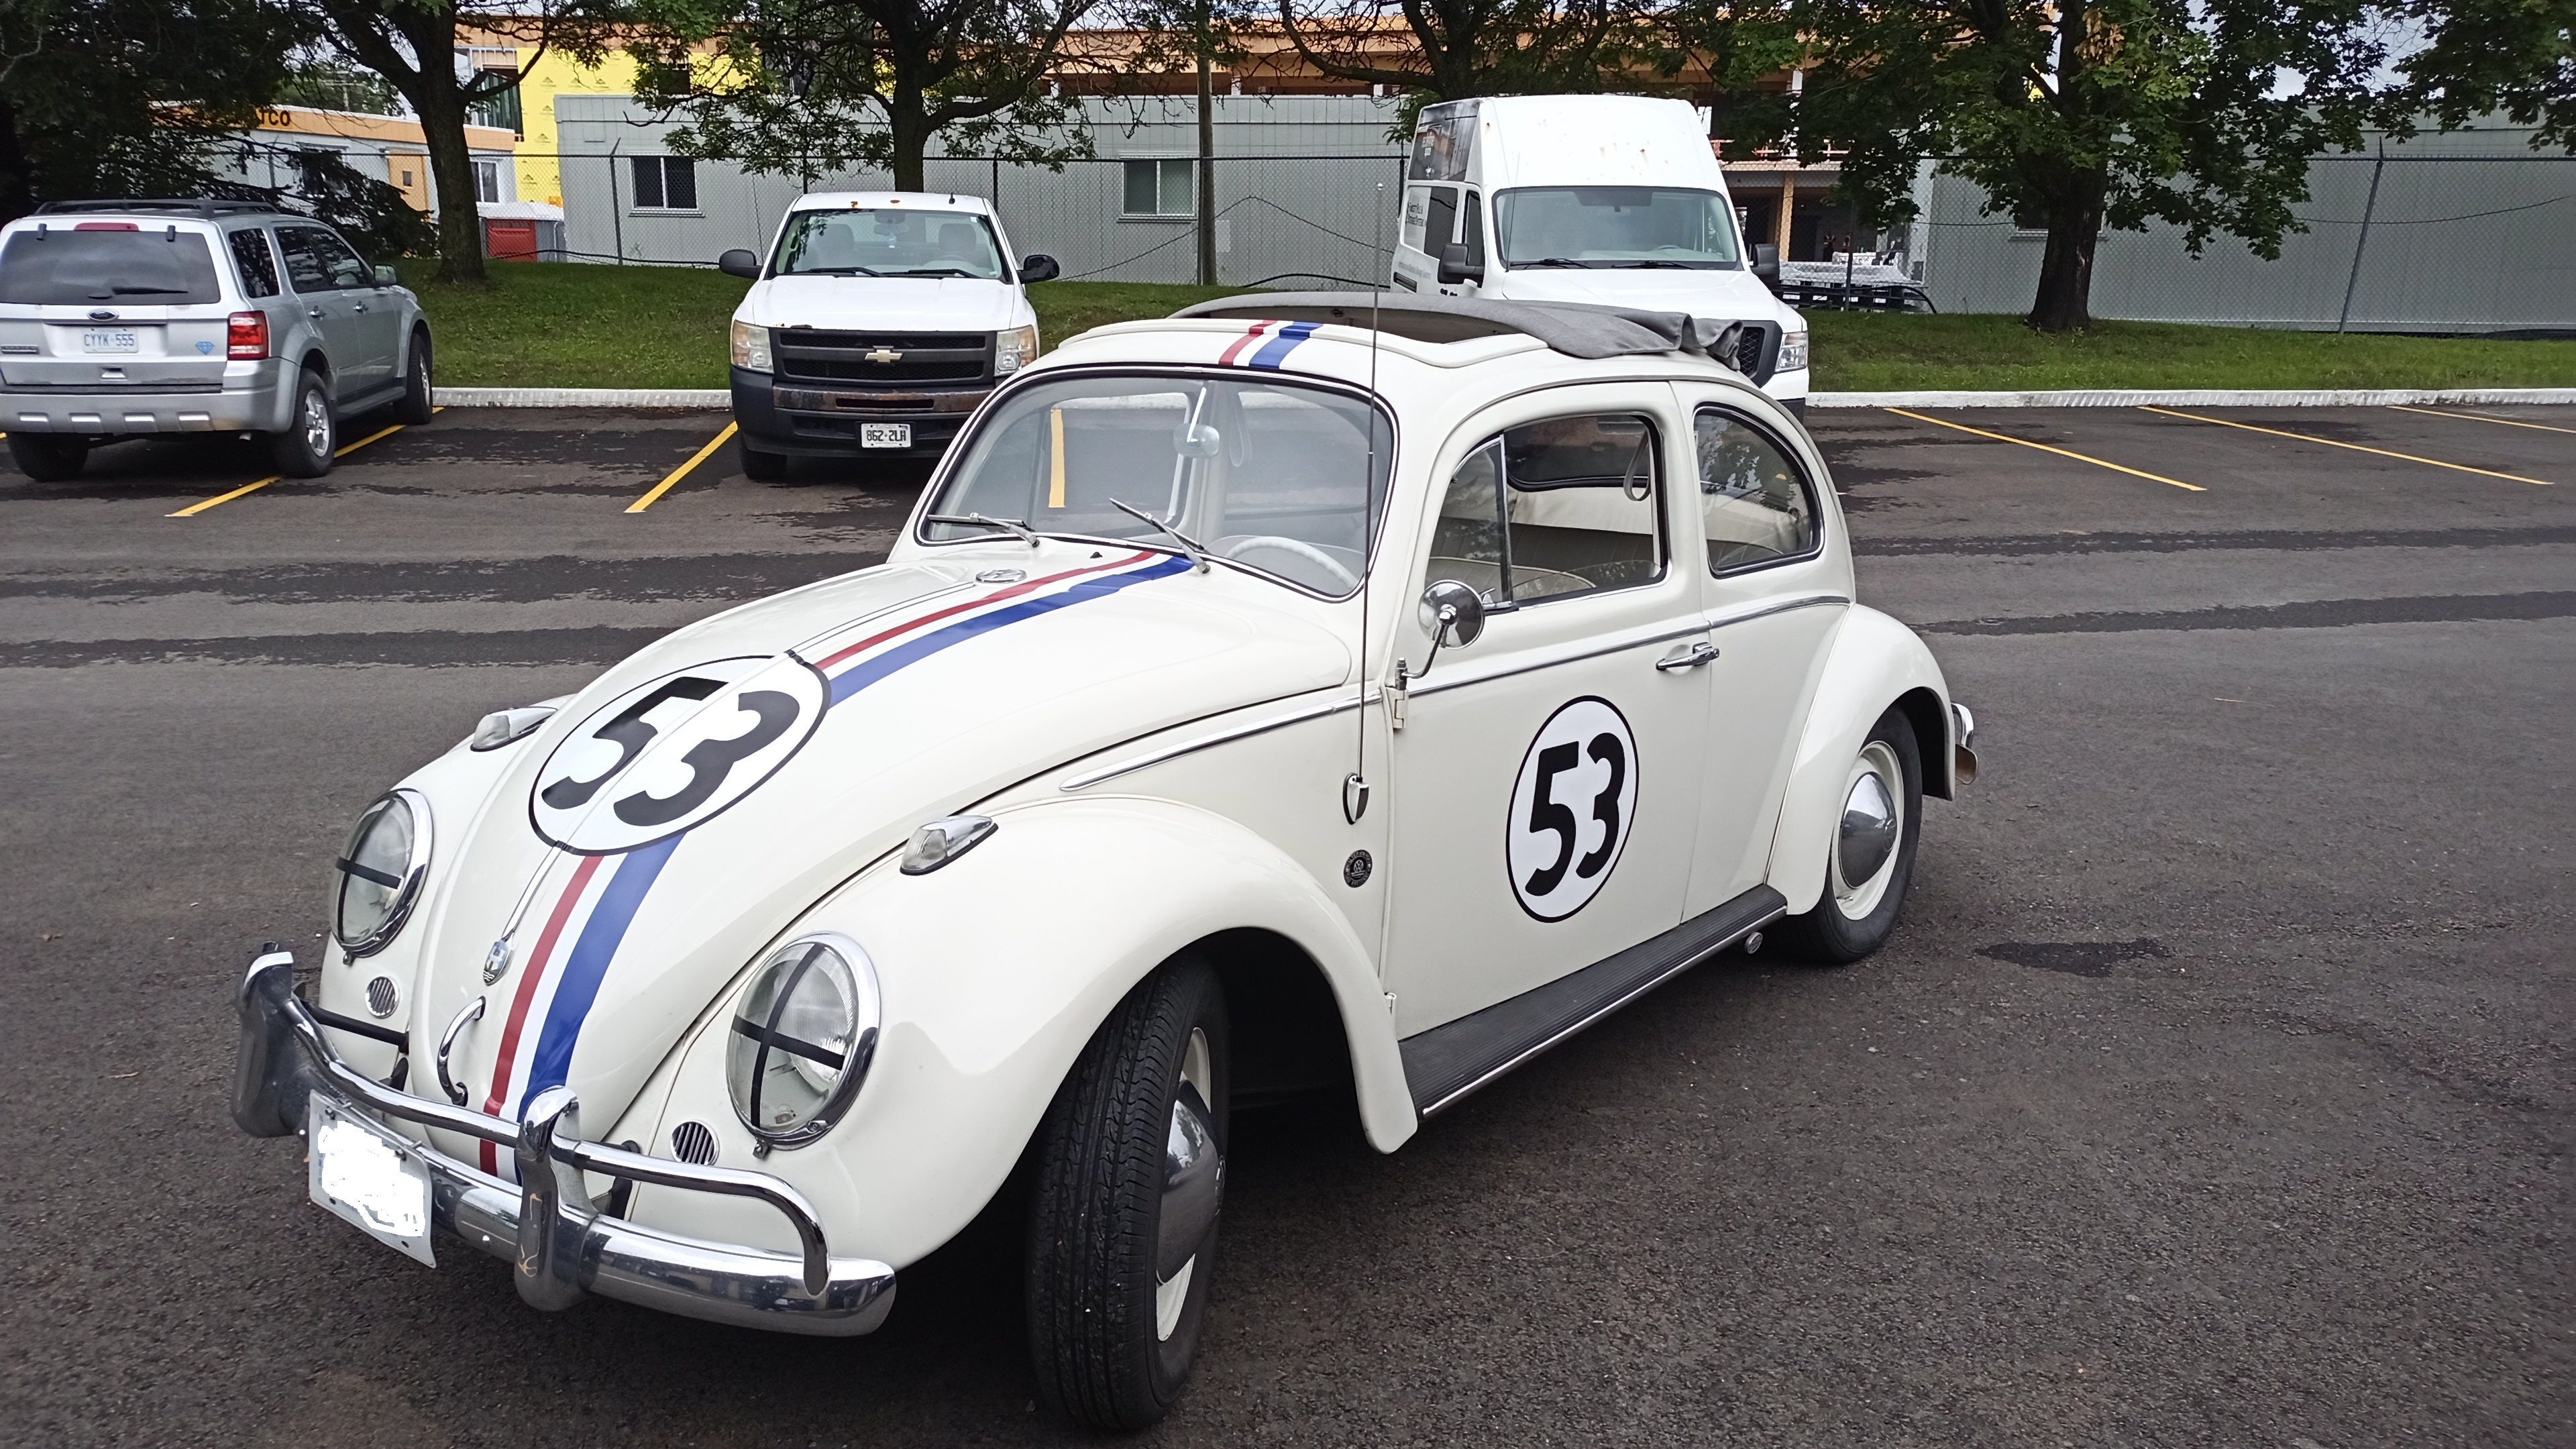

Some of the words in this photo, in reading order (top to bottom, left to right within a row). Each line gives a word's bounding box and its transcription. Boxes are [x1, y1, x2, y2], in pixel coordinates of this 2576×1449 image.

[259, 110, 290, 126] TCO
[115, 334, 134, 345] 555
[867, 430, 883, 441] 862
[889, 430, 906, 441] 2LH
[541, 677, 800, 826] 53
[1525, 733, 1625, 896] 53
